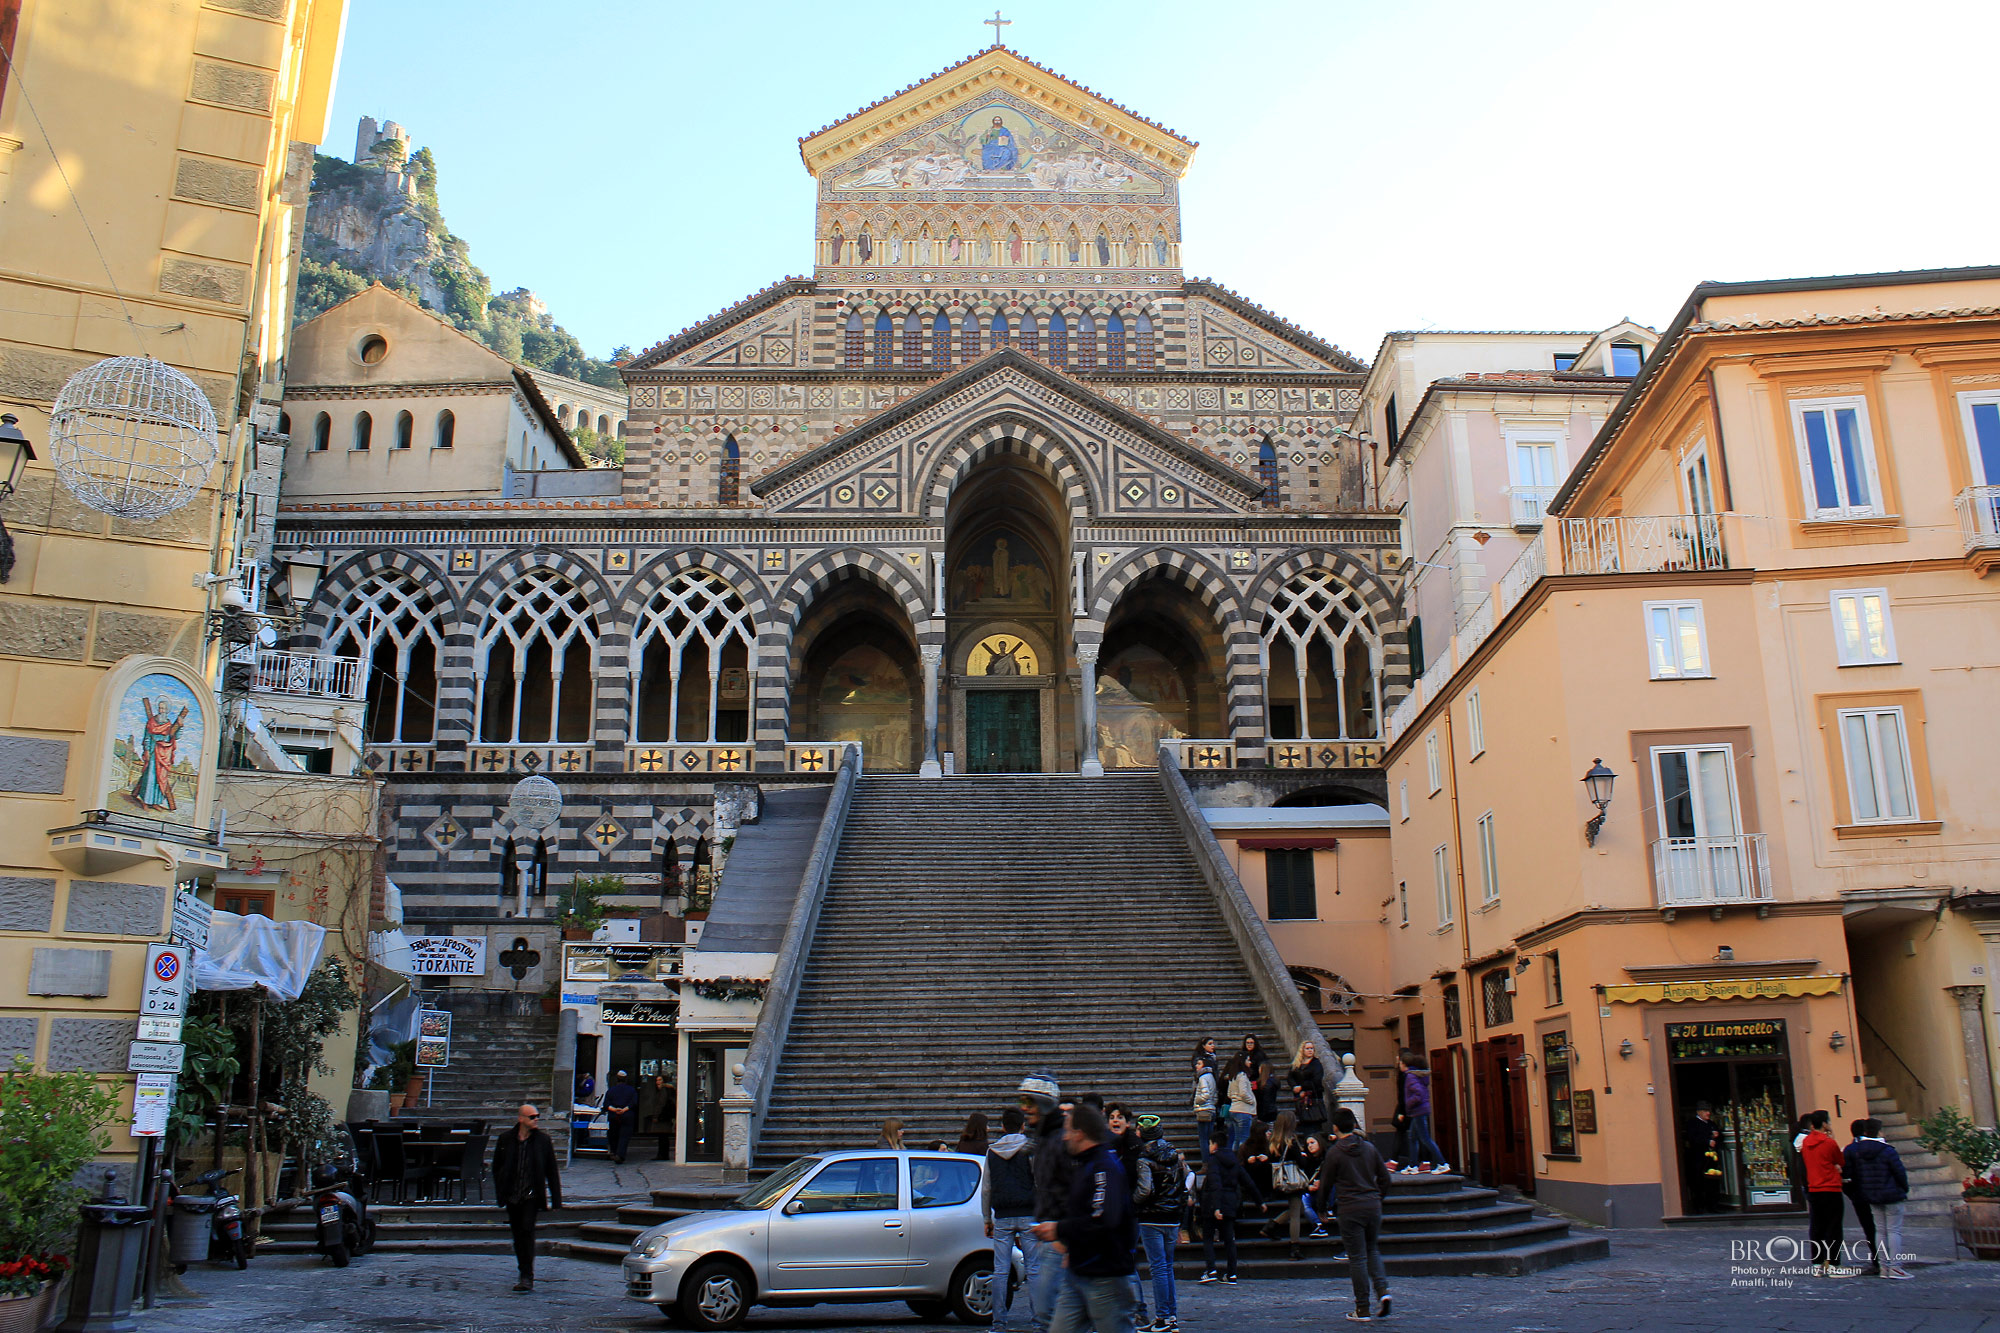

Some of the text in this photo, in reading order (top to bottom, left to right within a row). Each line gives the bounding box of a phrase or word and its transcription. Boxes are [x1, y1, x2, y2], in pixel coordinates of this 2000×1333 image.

[442, 938, 477, 959] APOSTOLI
[1704, 983, 1741, 996] Sapori
[1703, 1022, 1773, 1037] Limoncello
